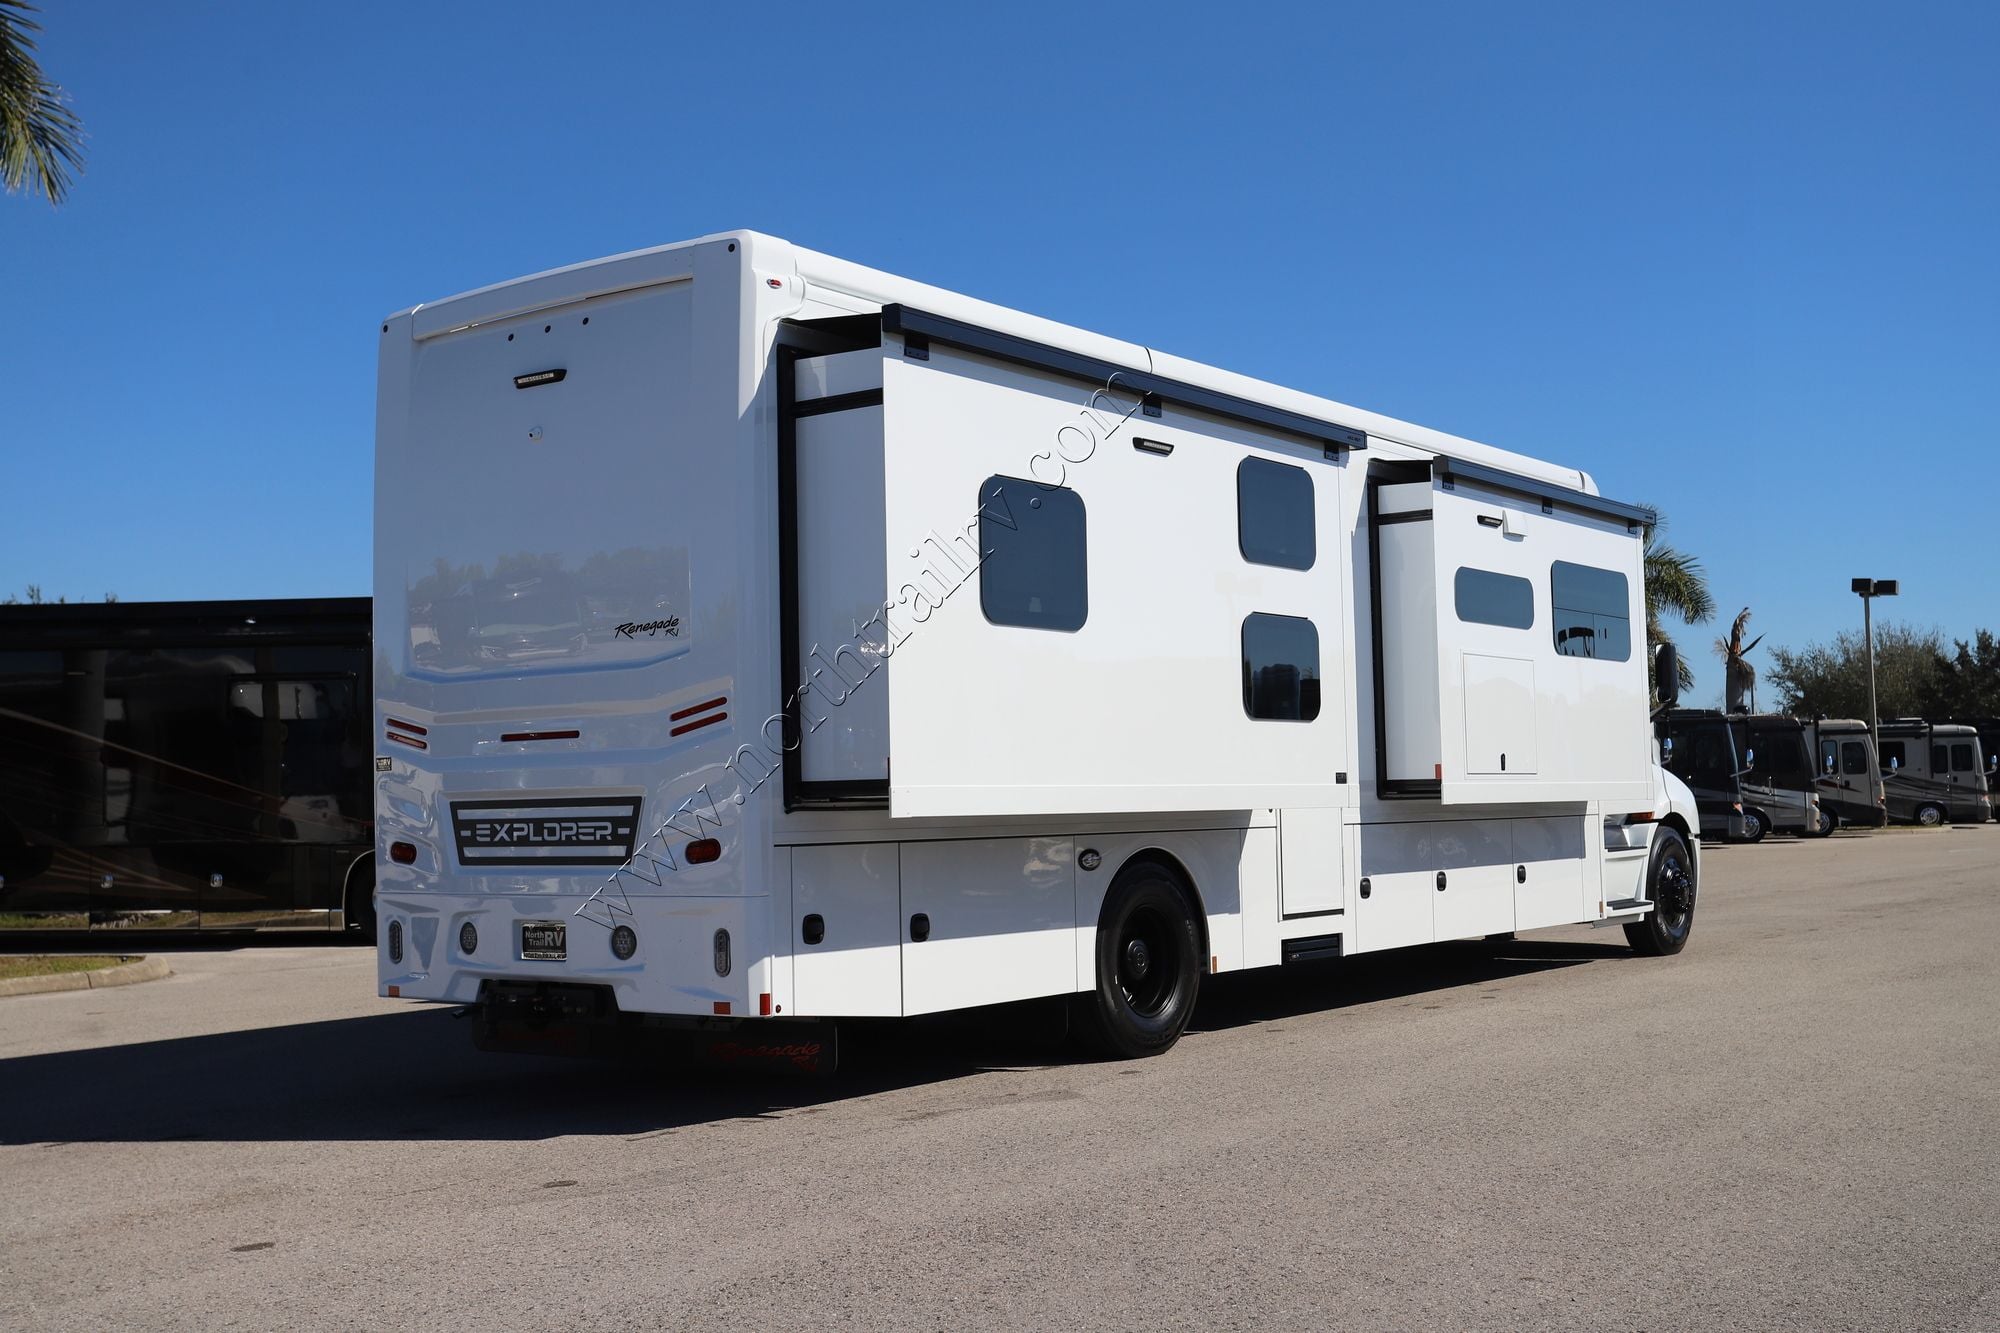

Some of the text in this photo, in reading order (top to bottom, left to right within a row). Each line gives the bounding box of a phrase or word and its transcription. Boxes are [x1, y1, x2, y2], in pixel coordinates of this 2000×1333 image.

[614, 614, 680, 640] Renegade
[665, 628, 680, 637] RV
[475, 821, 612, 842] EXPLORER
[525, 930, 564, 947] North RV
[528, 938, 544, 946] Trail
